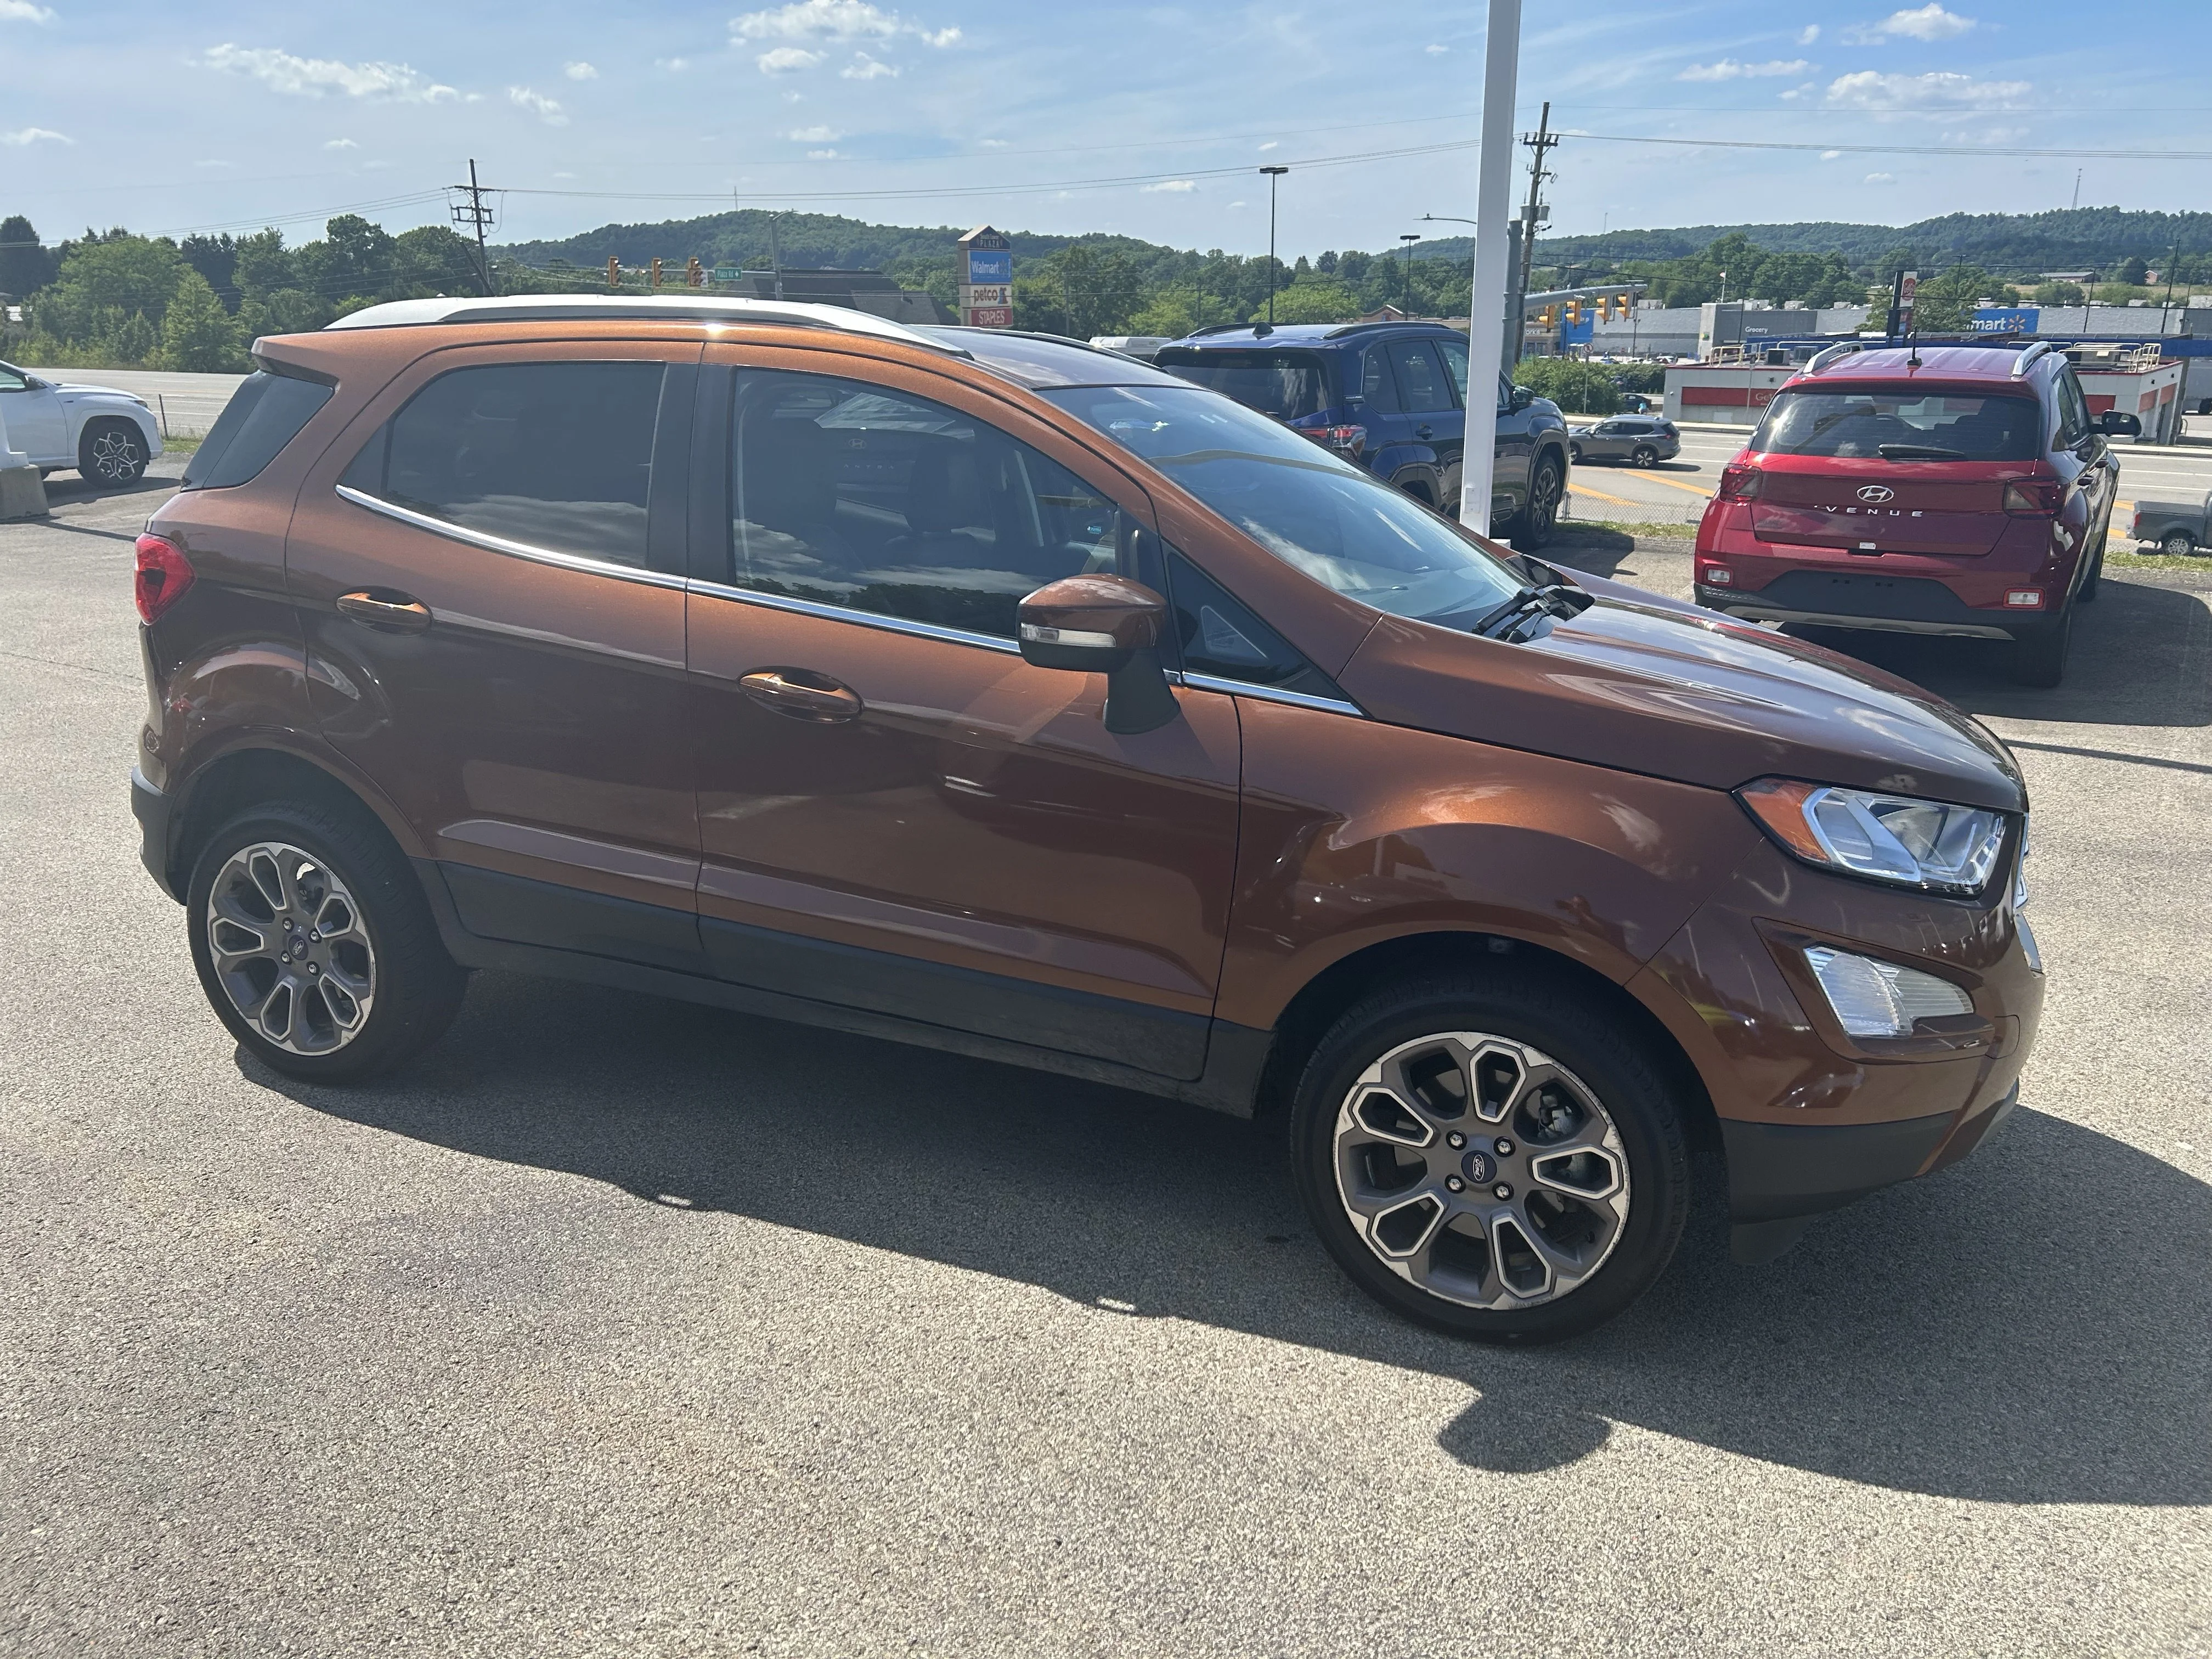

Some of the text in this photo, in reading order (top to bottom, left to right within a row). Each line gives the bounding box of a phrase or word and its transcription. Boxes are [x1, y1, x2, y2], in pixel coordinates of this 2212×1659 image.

[980, 239, 1000, 248] PLAZA
[972, 260, 999, 274] Walmart
[974, 287, 998, 305] petco
[979, 311, 1005, 324] STAPLES
[1966, 317, 2006, 331] mart
[1825, 505, 1923, 517] VENUE
